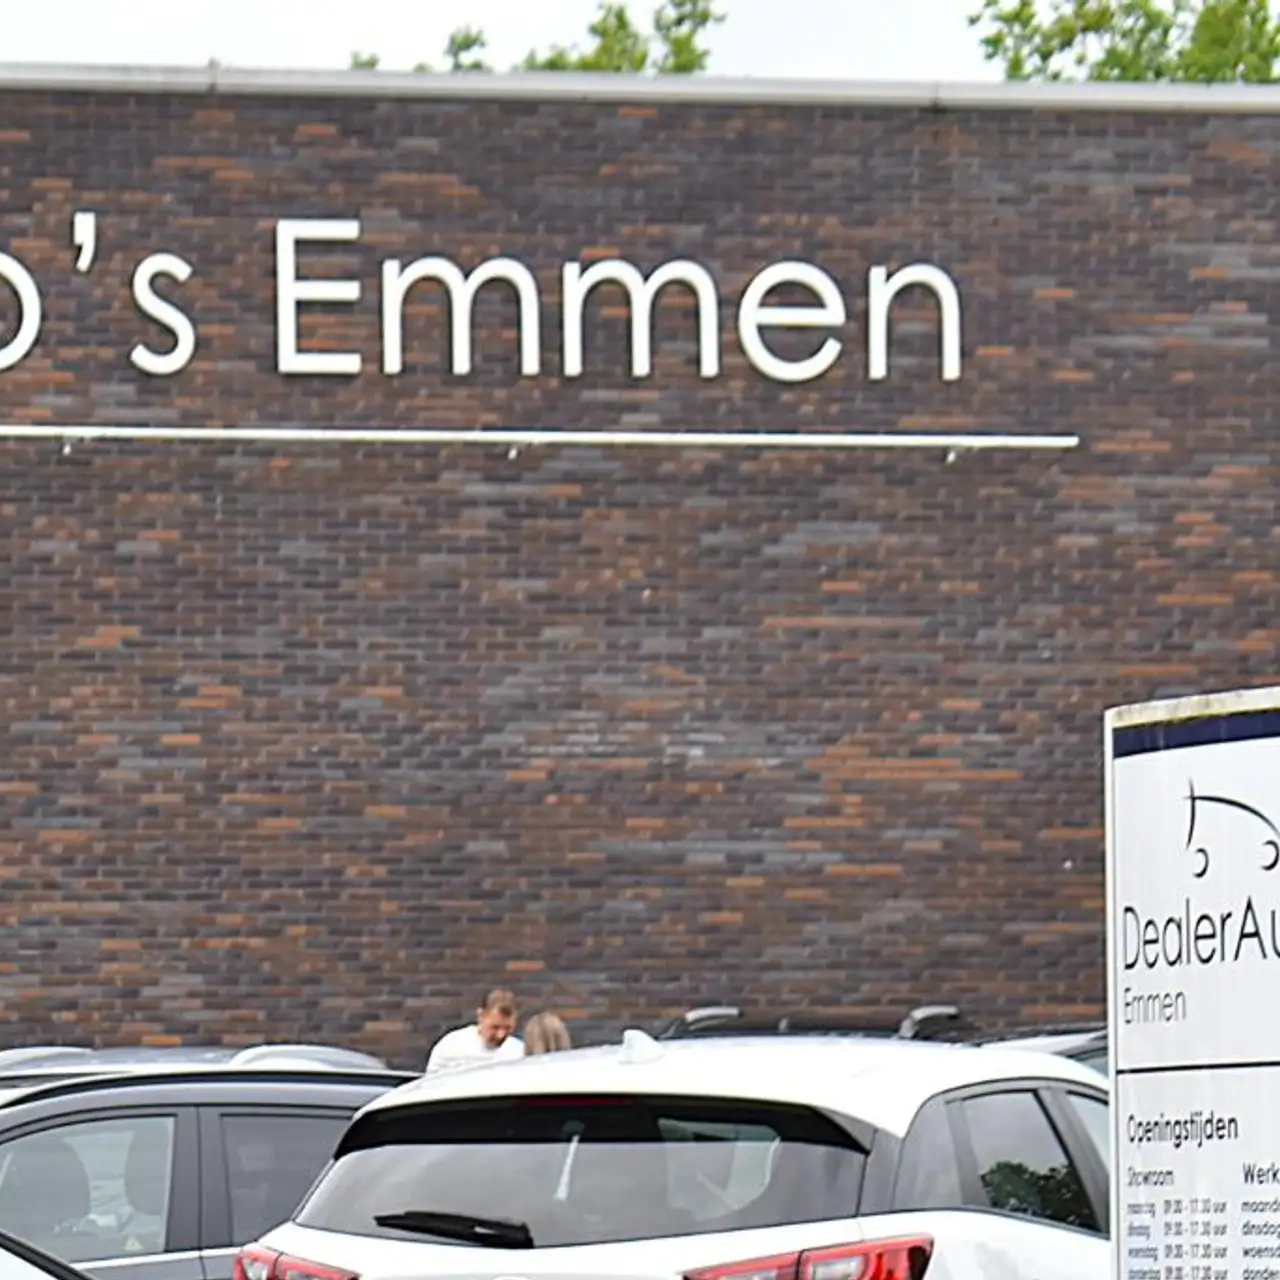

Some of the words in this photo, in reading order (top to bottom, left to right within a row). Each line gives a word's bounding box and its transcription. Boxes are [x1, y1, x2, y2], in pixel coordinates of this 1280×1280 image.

[276, 218, 962, 382] Emmen
[1124, 986, 1186, 1025] Emmen
[1127, 1110, 1239, 1150] Openingstijden
